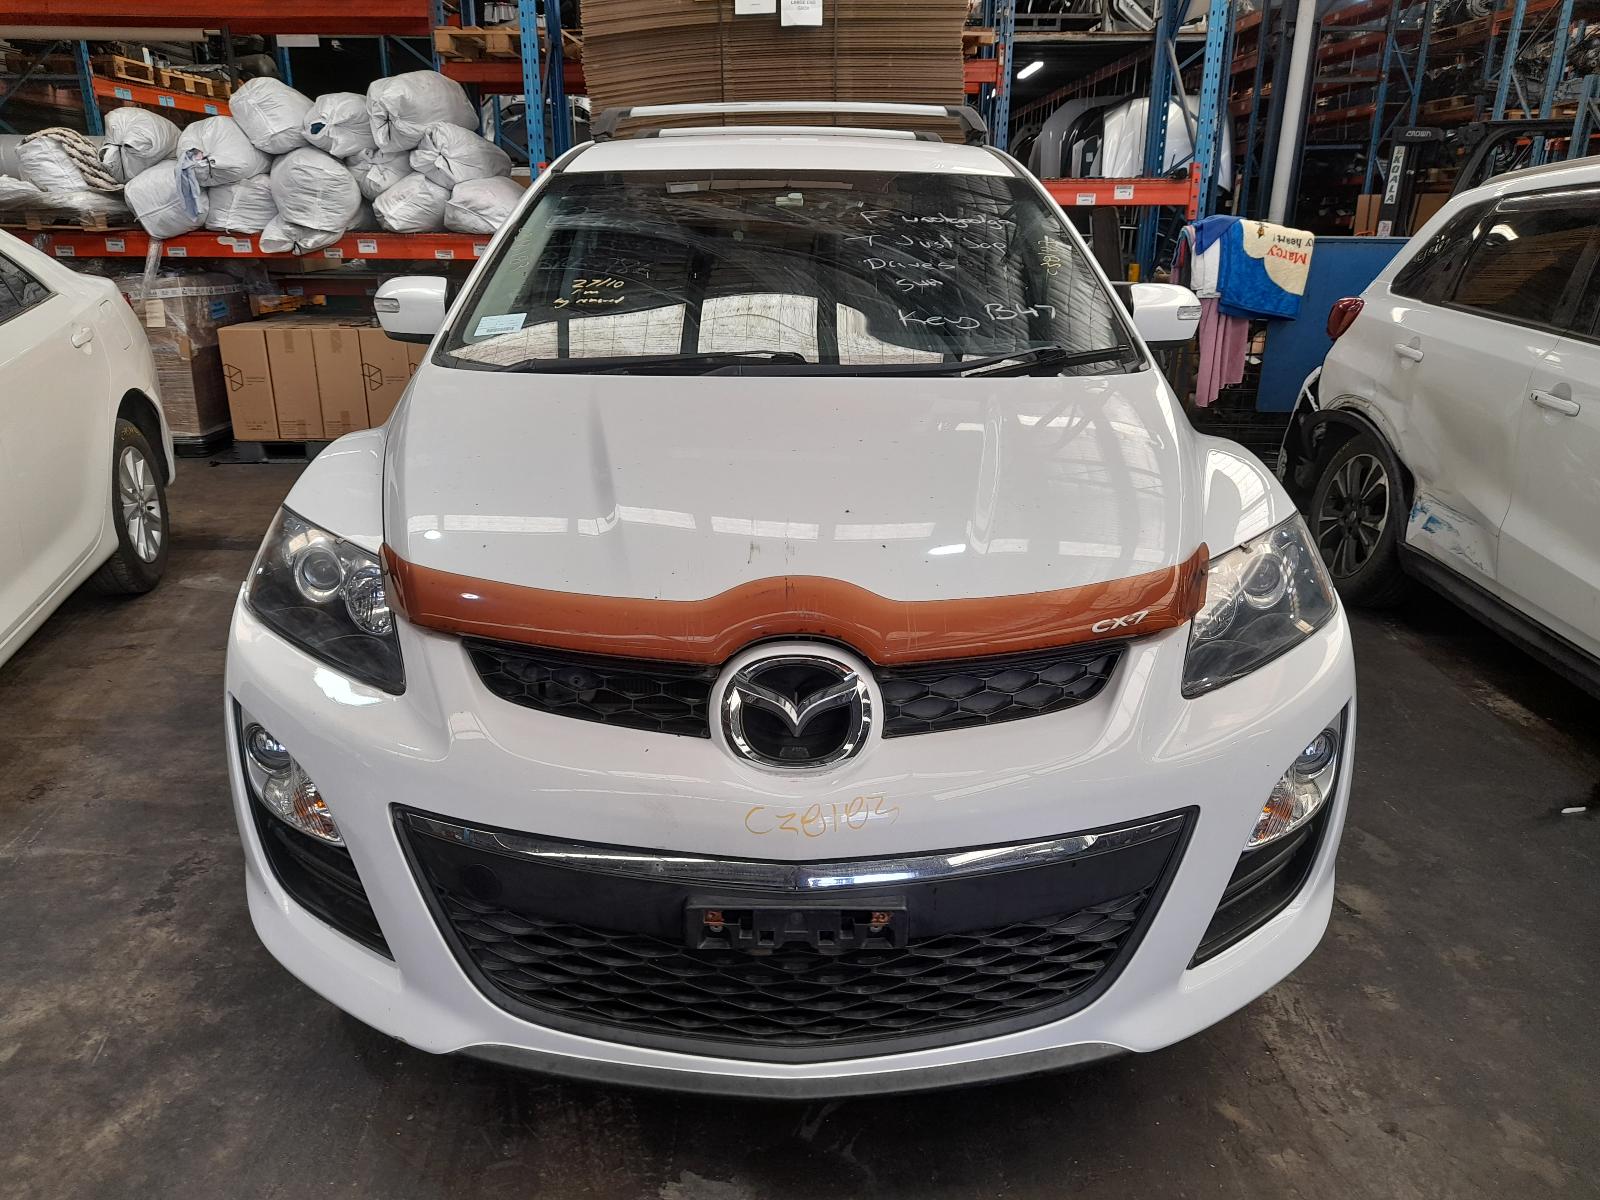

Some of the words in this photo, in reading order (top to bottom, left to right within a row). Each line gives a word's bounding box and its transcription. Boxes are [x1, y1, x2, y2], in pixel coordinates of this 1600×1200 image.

[1386, 155, 1402, 202] KOALA
[1266, 244, 1308, 265] Marcy
[571, 277, 625, 289] 27/10
[898, 309, 981, 330] Key
[1091, 609, 1149, 633] CX-7
